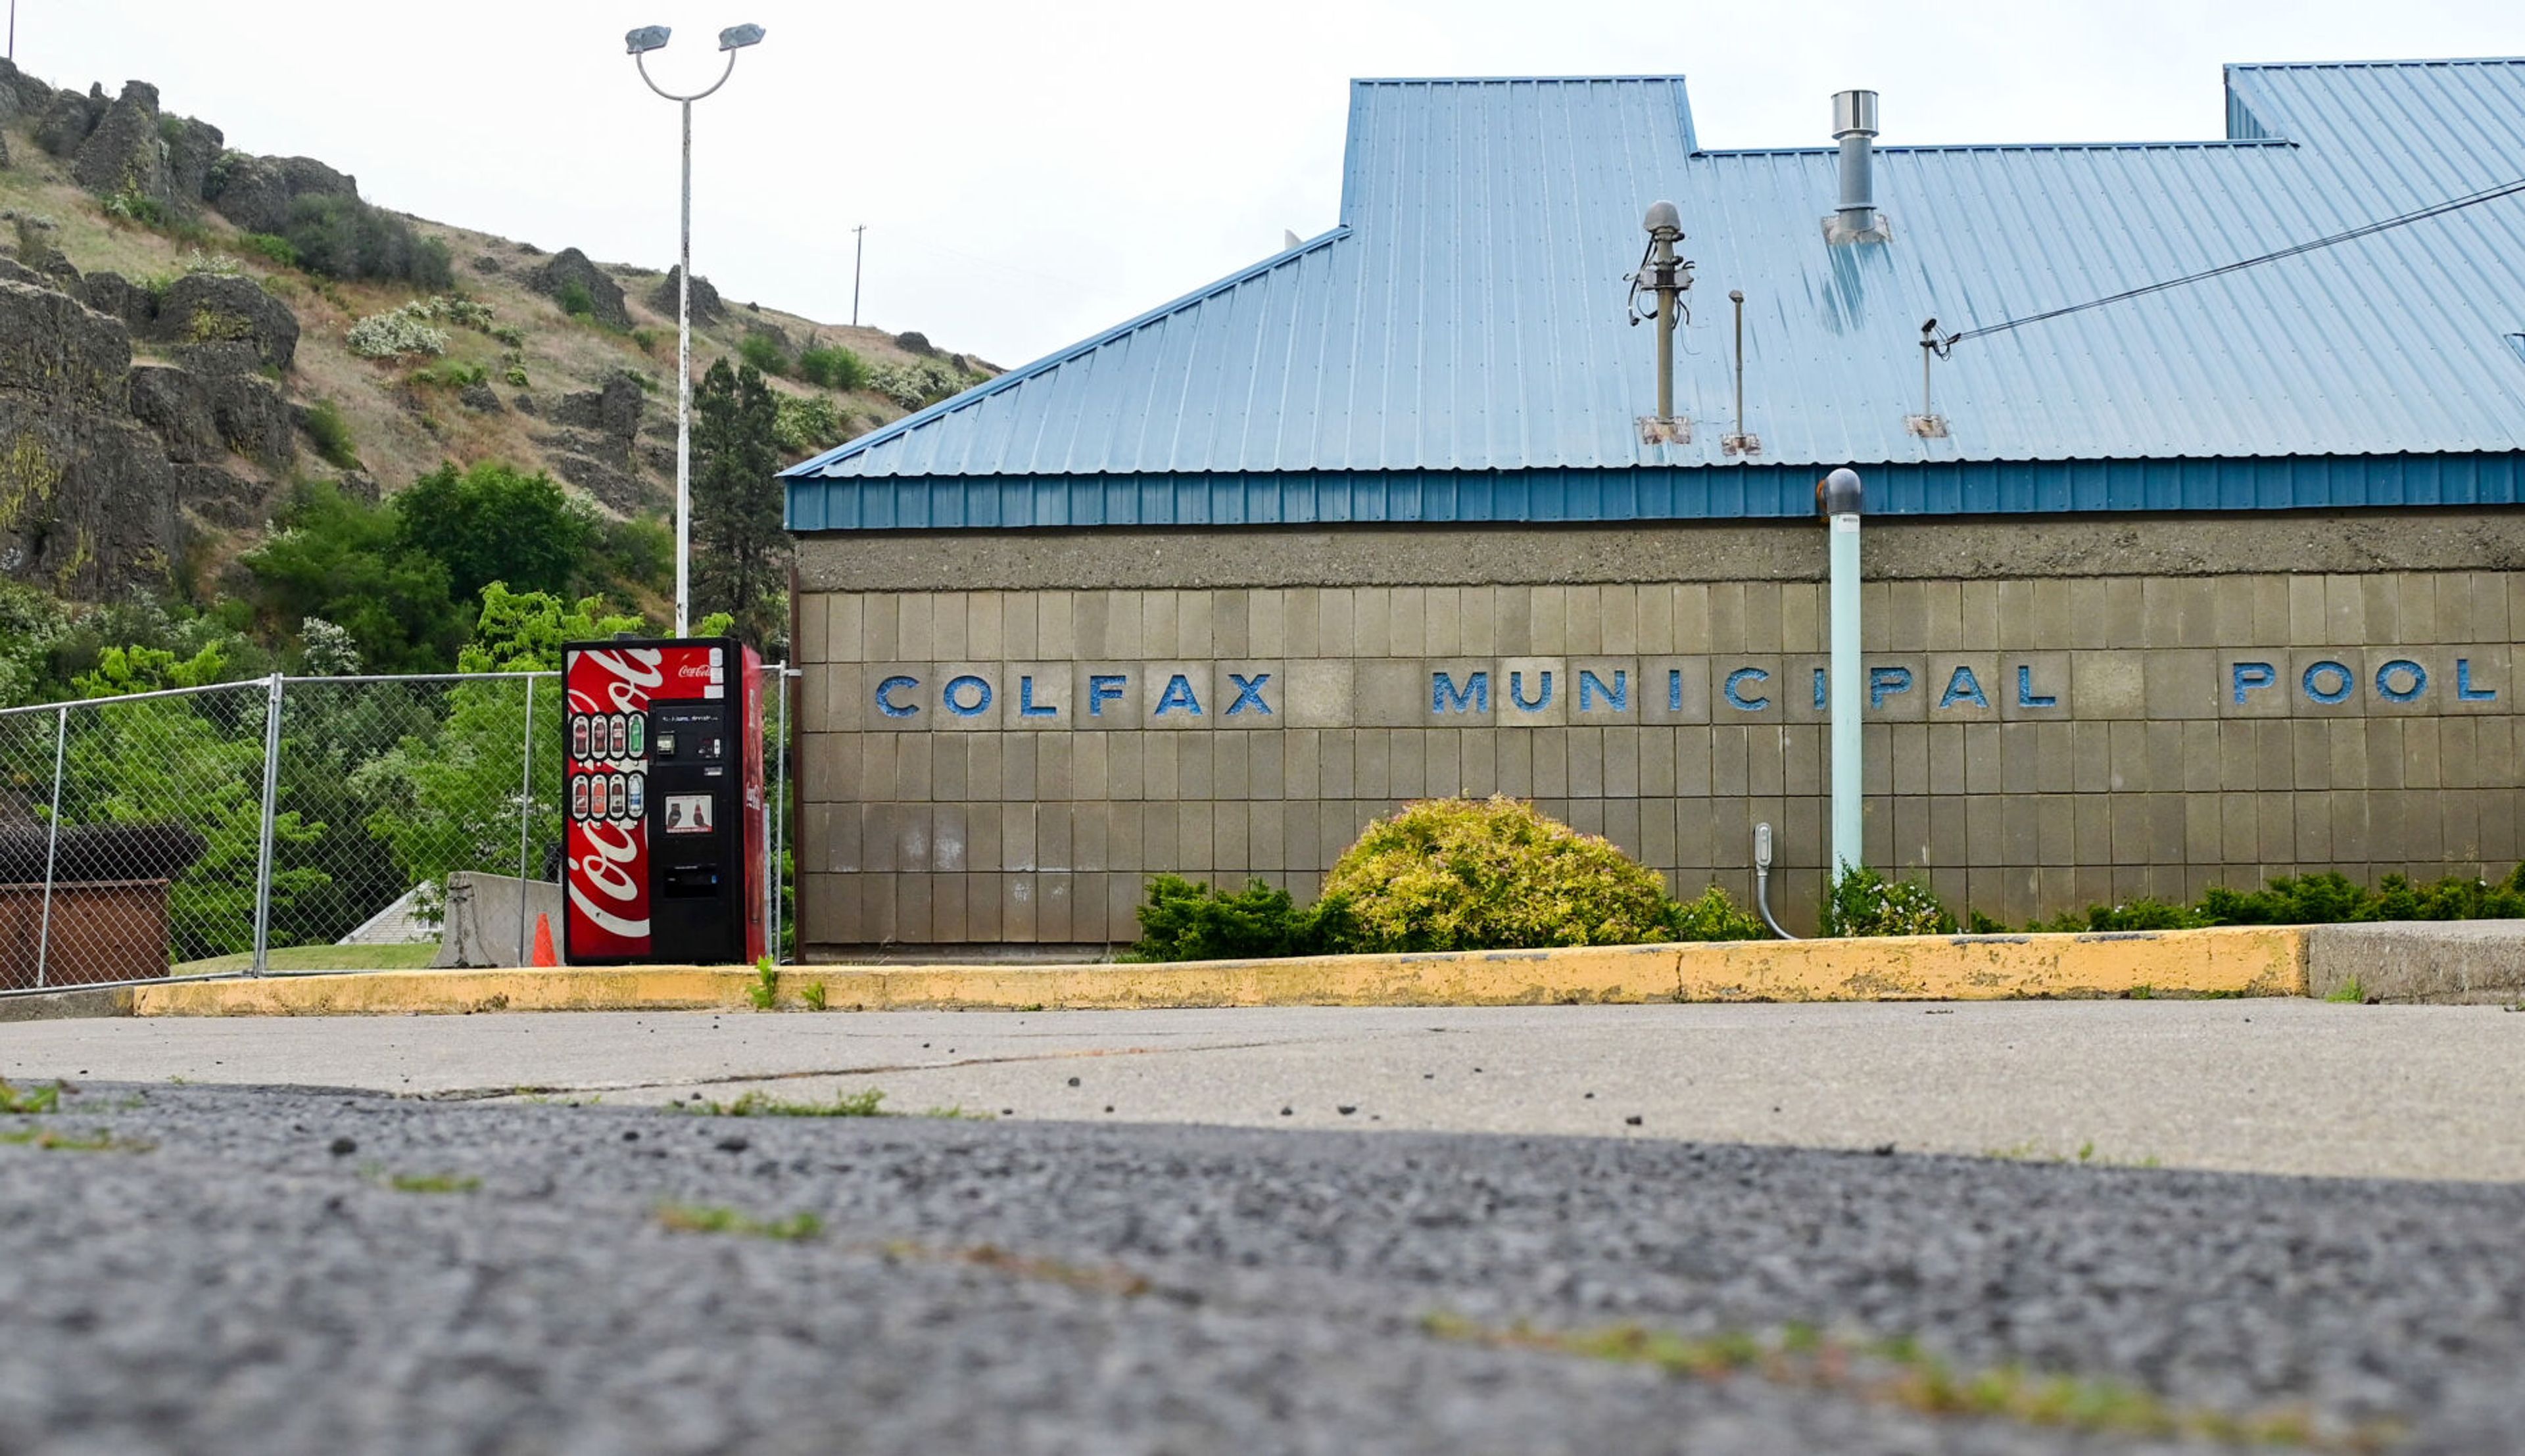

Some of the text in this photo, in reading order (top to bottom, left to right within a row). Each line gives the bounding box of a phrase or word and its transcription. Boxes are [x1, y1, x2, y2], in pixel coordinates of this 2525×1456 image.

[875, 659, 2497, 718] COLFAX MUNICIPAL POOL
